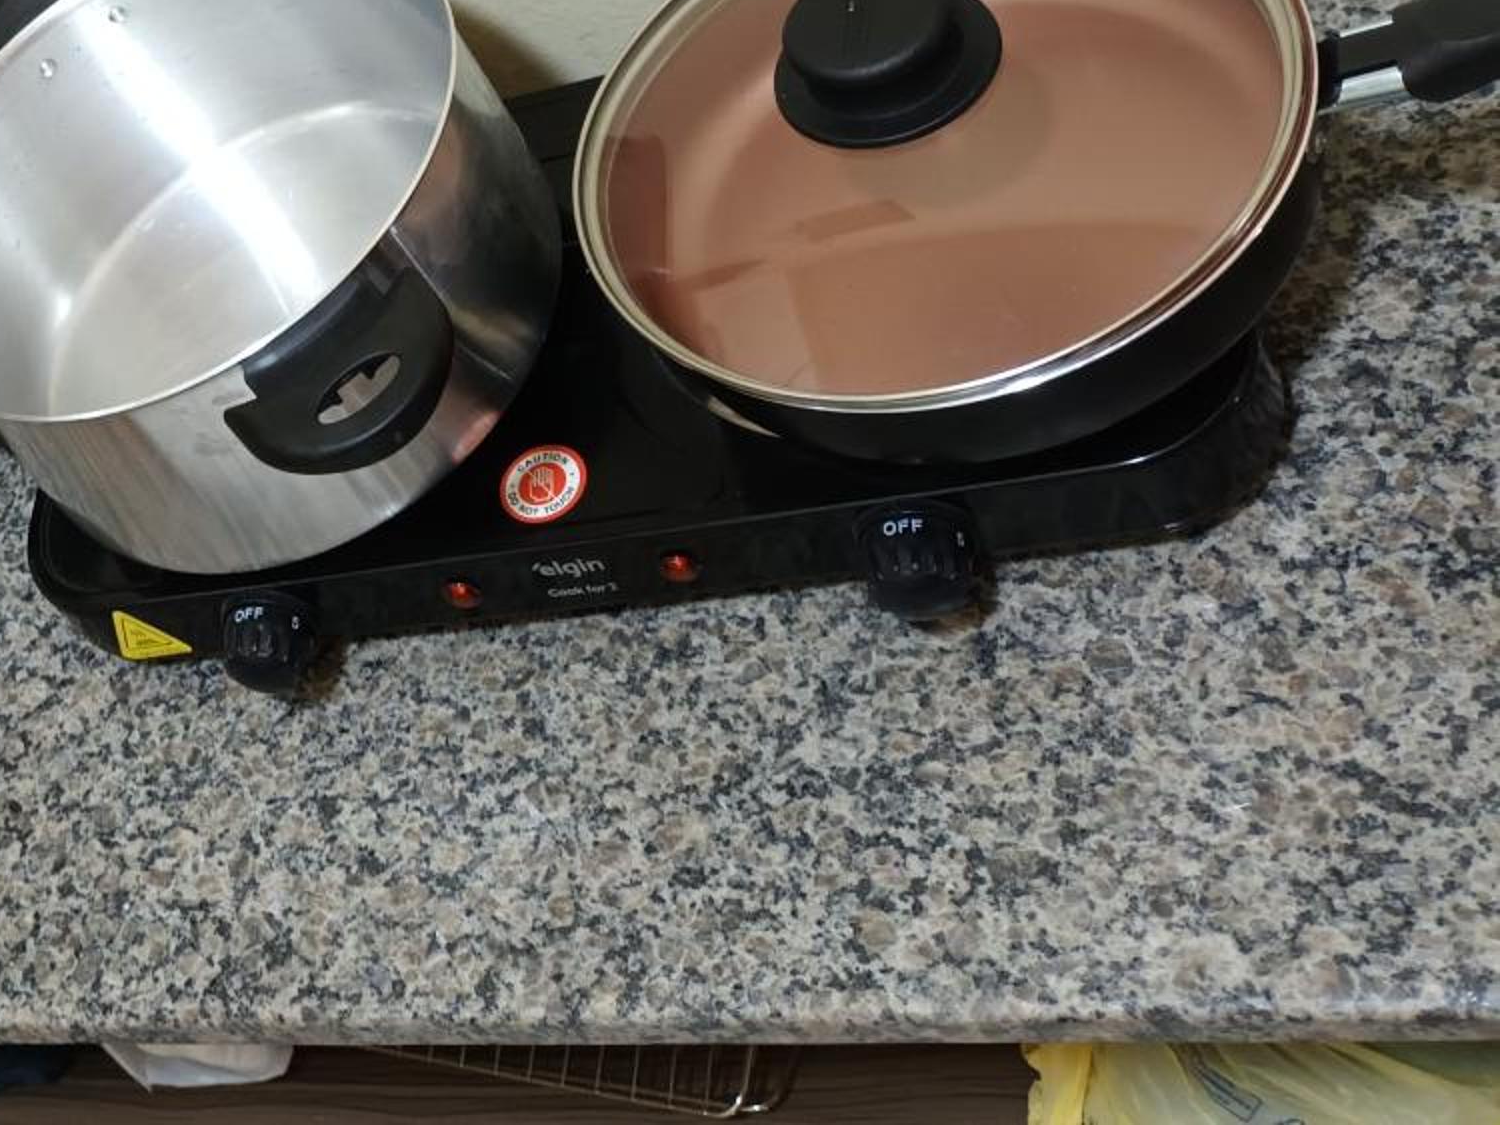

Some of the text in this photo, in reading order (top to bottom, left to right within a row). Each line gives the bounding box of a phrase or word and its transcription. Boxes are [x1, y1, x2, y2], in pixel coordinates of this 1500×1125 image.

[516, 452, 569, 473] CAUTION
[543, 486, 575, 515] TOUCH
[883, 518, 924, 536] OFF
[234, 606, 264, 623] OFF
